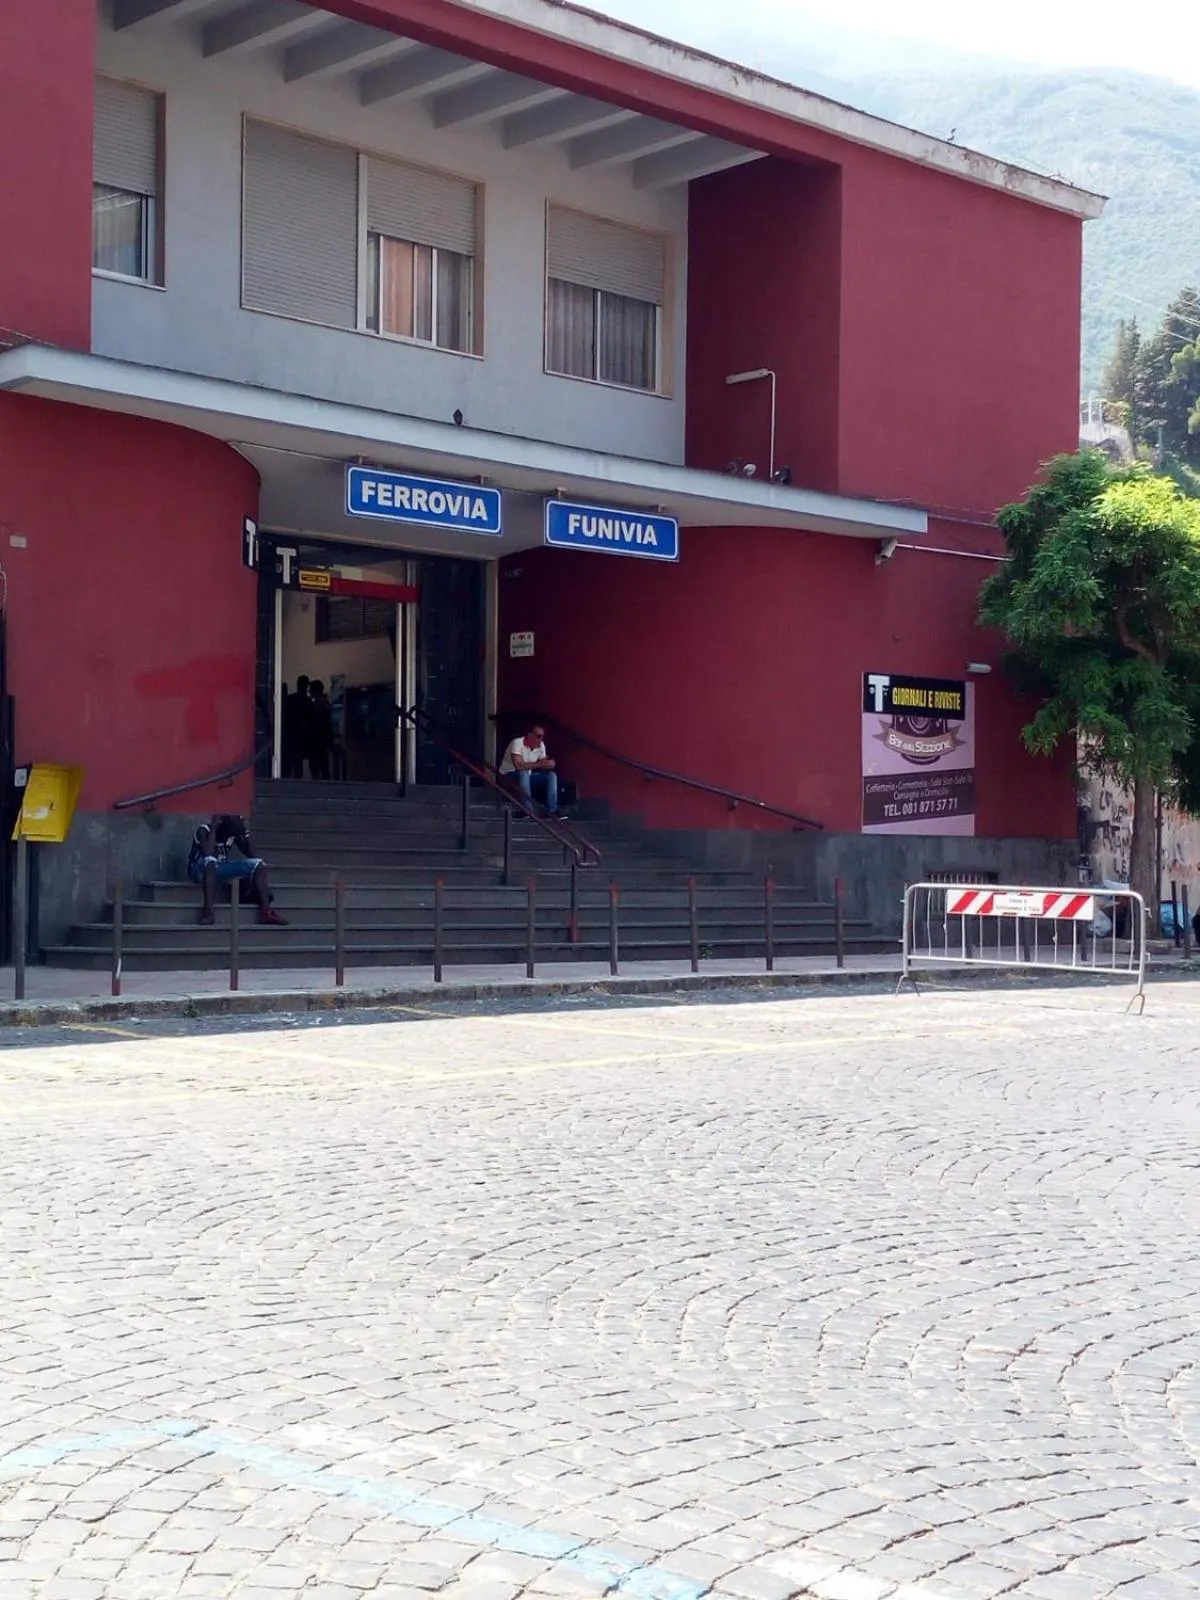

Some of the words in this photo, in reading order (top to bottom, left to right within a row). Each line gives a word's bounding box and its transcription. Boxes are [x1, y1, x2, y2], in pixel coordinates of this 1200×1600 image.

[361, 480, 488, 521] FERROVIA
[568, 513, 658, 546] FUNIVIA
[276, 546, 297, 584] T
[868, 674, 890, 712] T
[892, 687, 926, 707] GIORNALI
[928, 690, 934, 708] E
[889, 734, 901, 747] Bar
[915, 740, 951, 752] Stazione
[884, 803, 901, 817] TEL.
[902, 803, 917, 815] 081
[919, 801, 935, 813] 871
[936, 799, 947, 811] 57
[948, 797, 958, 811] 71
